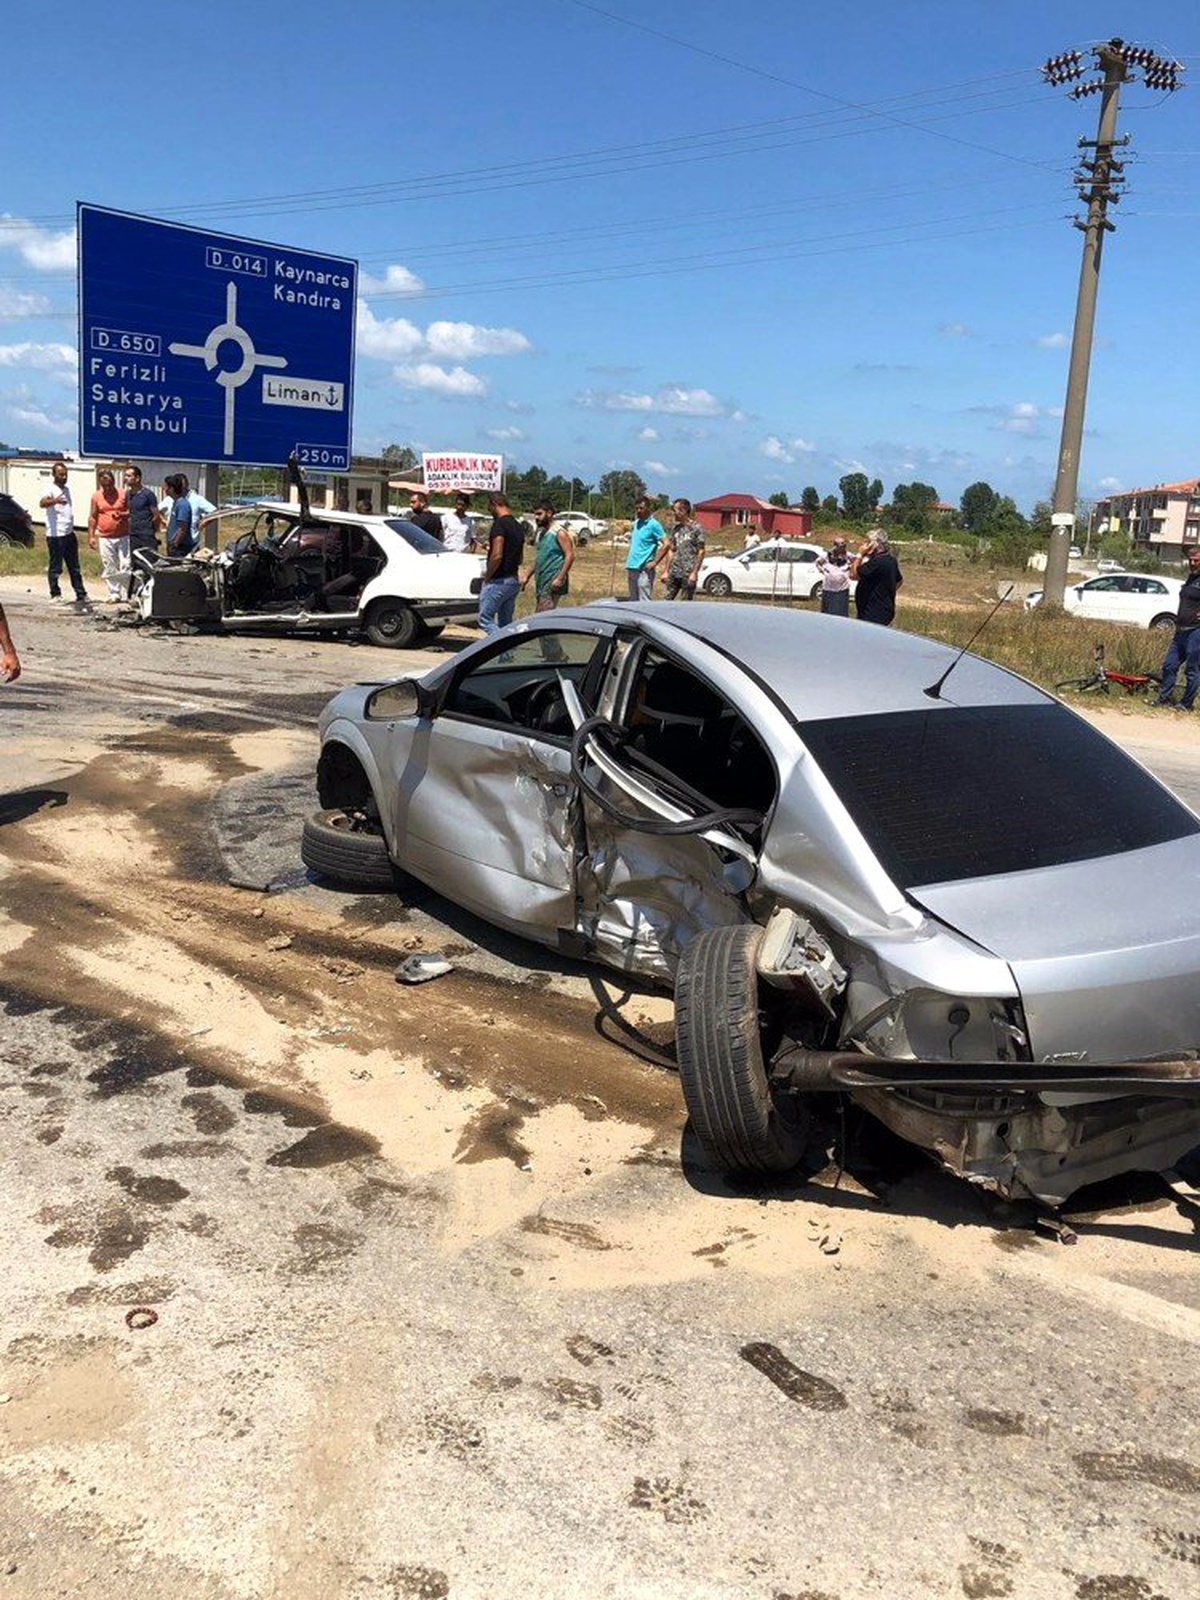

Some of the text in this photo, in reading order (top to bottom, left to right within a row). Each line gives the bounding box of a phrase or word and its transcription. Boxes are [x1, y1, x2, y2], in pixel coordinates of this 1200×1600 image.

[274, 260, 350, 288] Kaynarca
[273, 283, 341, 310] Kandıra
[91, 358, 166, 382] Ferizli
[91, 383, 182, 412] Sakarya
[268, 381, 321, 402] Liman
[91, 405, 187, 434] İstanbul
[300, 449, 345, 464] 250 m
[426, 457, 479, 472] KURBANLIK
[427, 473, 459, 481] ADAKLIK
